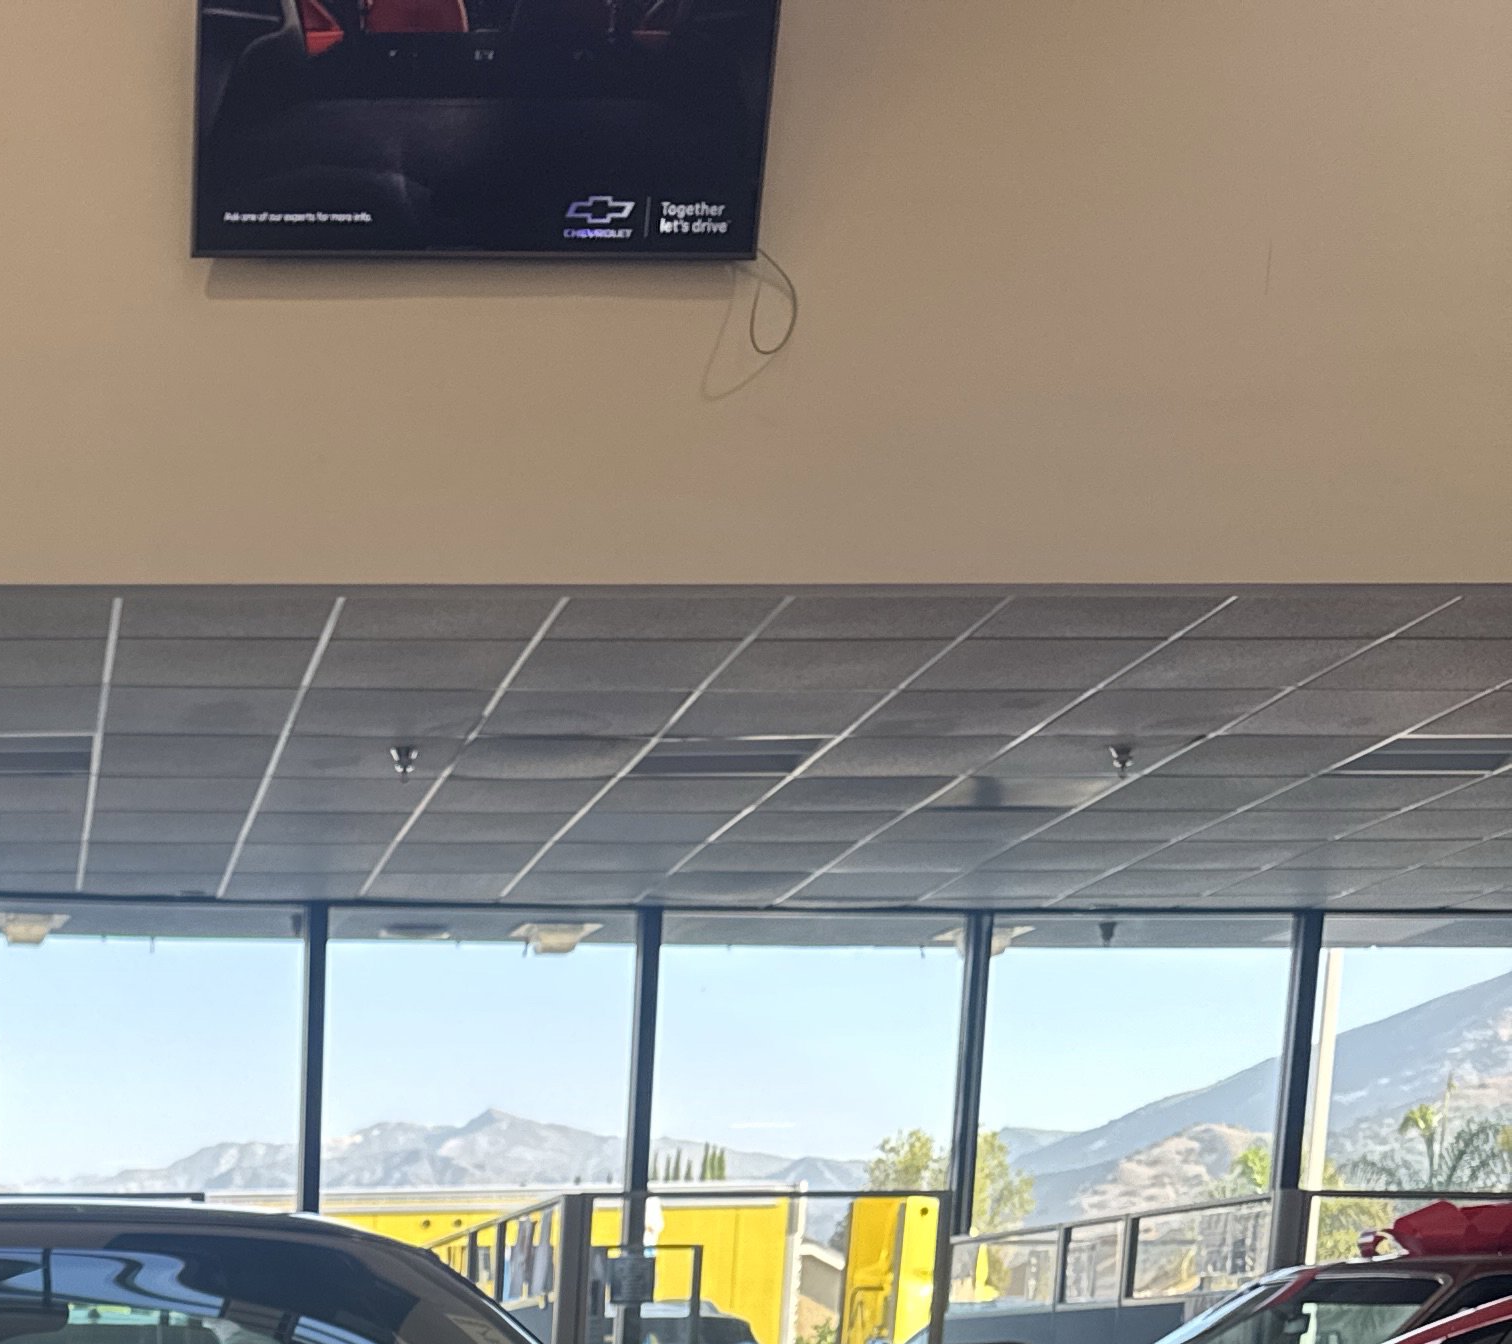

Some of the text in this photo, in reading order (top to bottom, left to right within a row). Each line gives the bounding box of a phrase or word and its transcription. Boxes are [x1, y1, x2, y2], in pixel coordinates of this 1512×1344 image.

[661, 201, 725, 218] Together
[563, 228, 633, 238] CHEVROLET
[660, 217, 728, 233] let's drive
